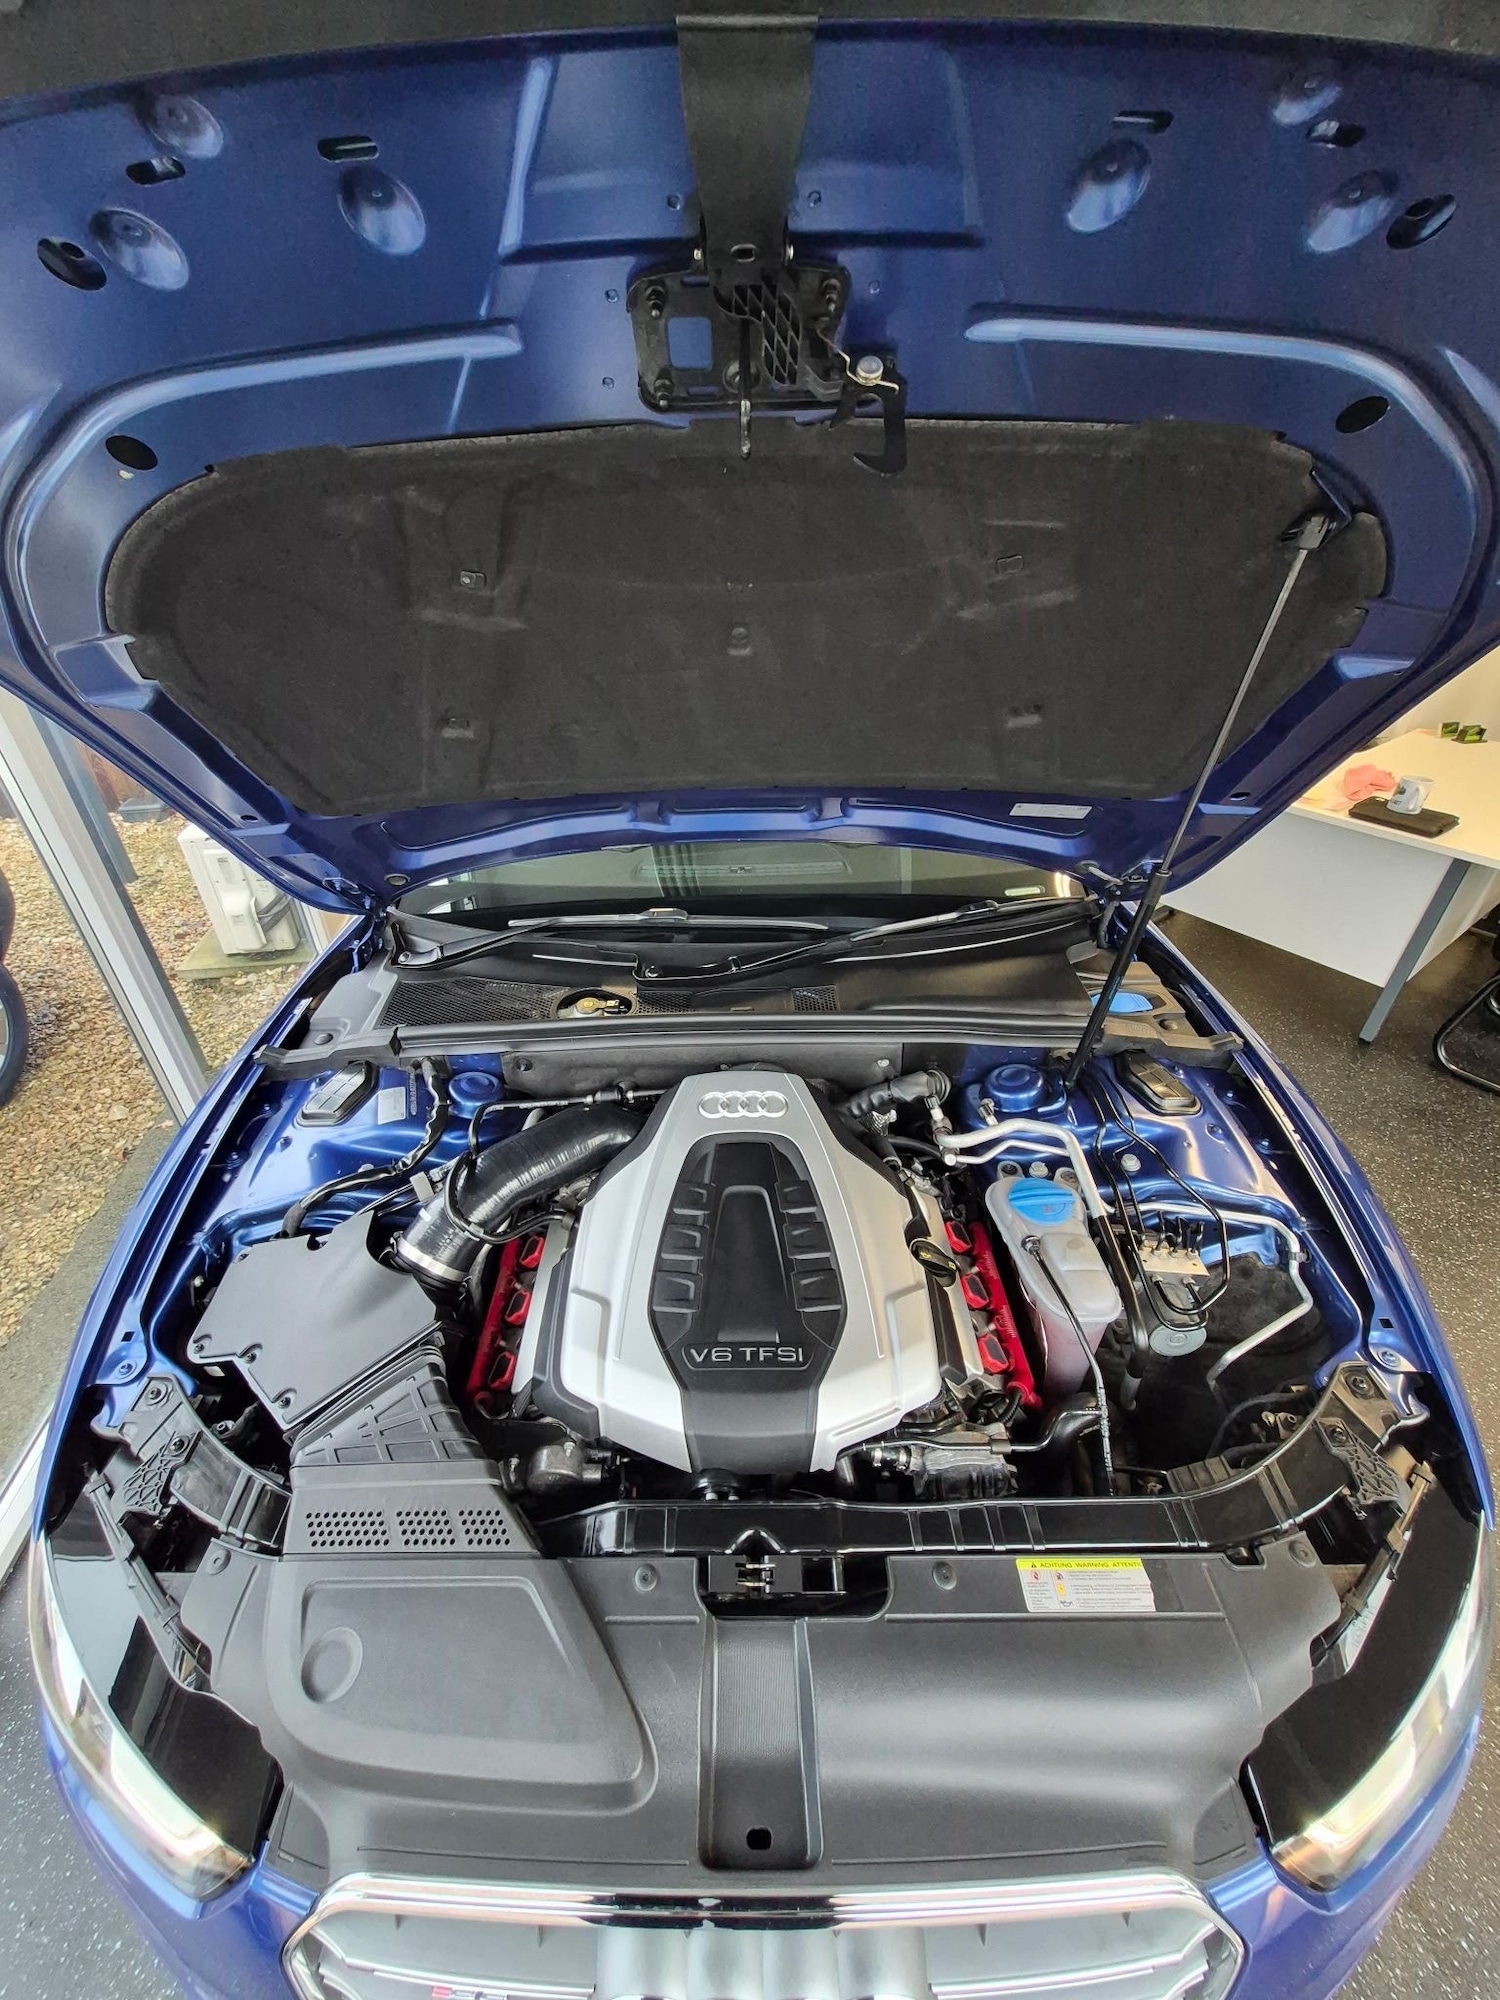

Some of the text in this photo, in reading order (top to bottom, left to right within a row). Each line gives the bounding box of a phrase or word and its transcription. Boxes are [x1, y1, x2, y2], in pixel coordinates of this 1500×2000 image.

[690, 1347, 803, 1362] V6 TFSI
[1040, 1561, 1073, 1569] ACHTUNG
[1075, 1561, 1109, 1569] WARNING
